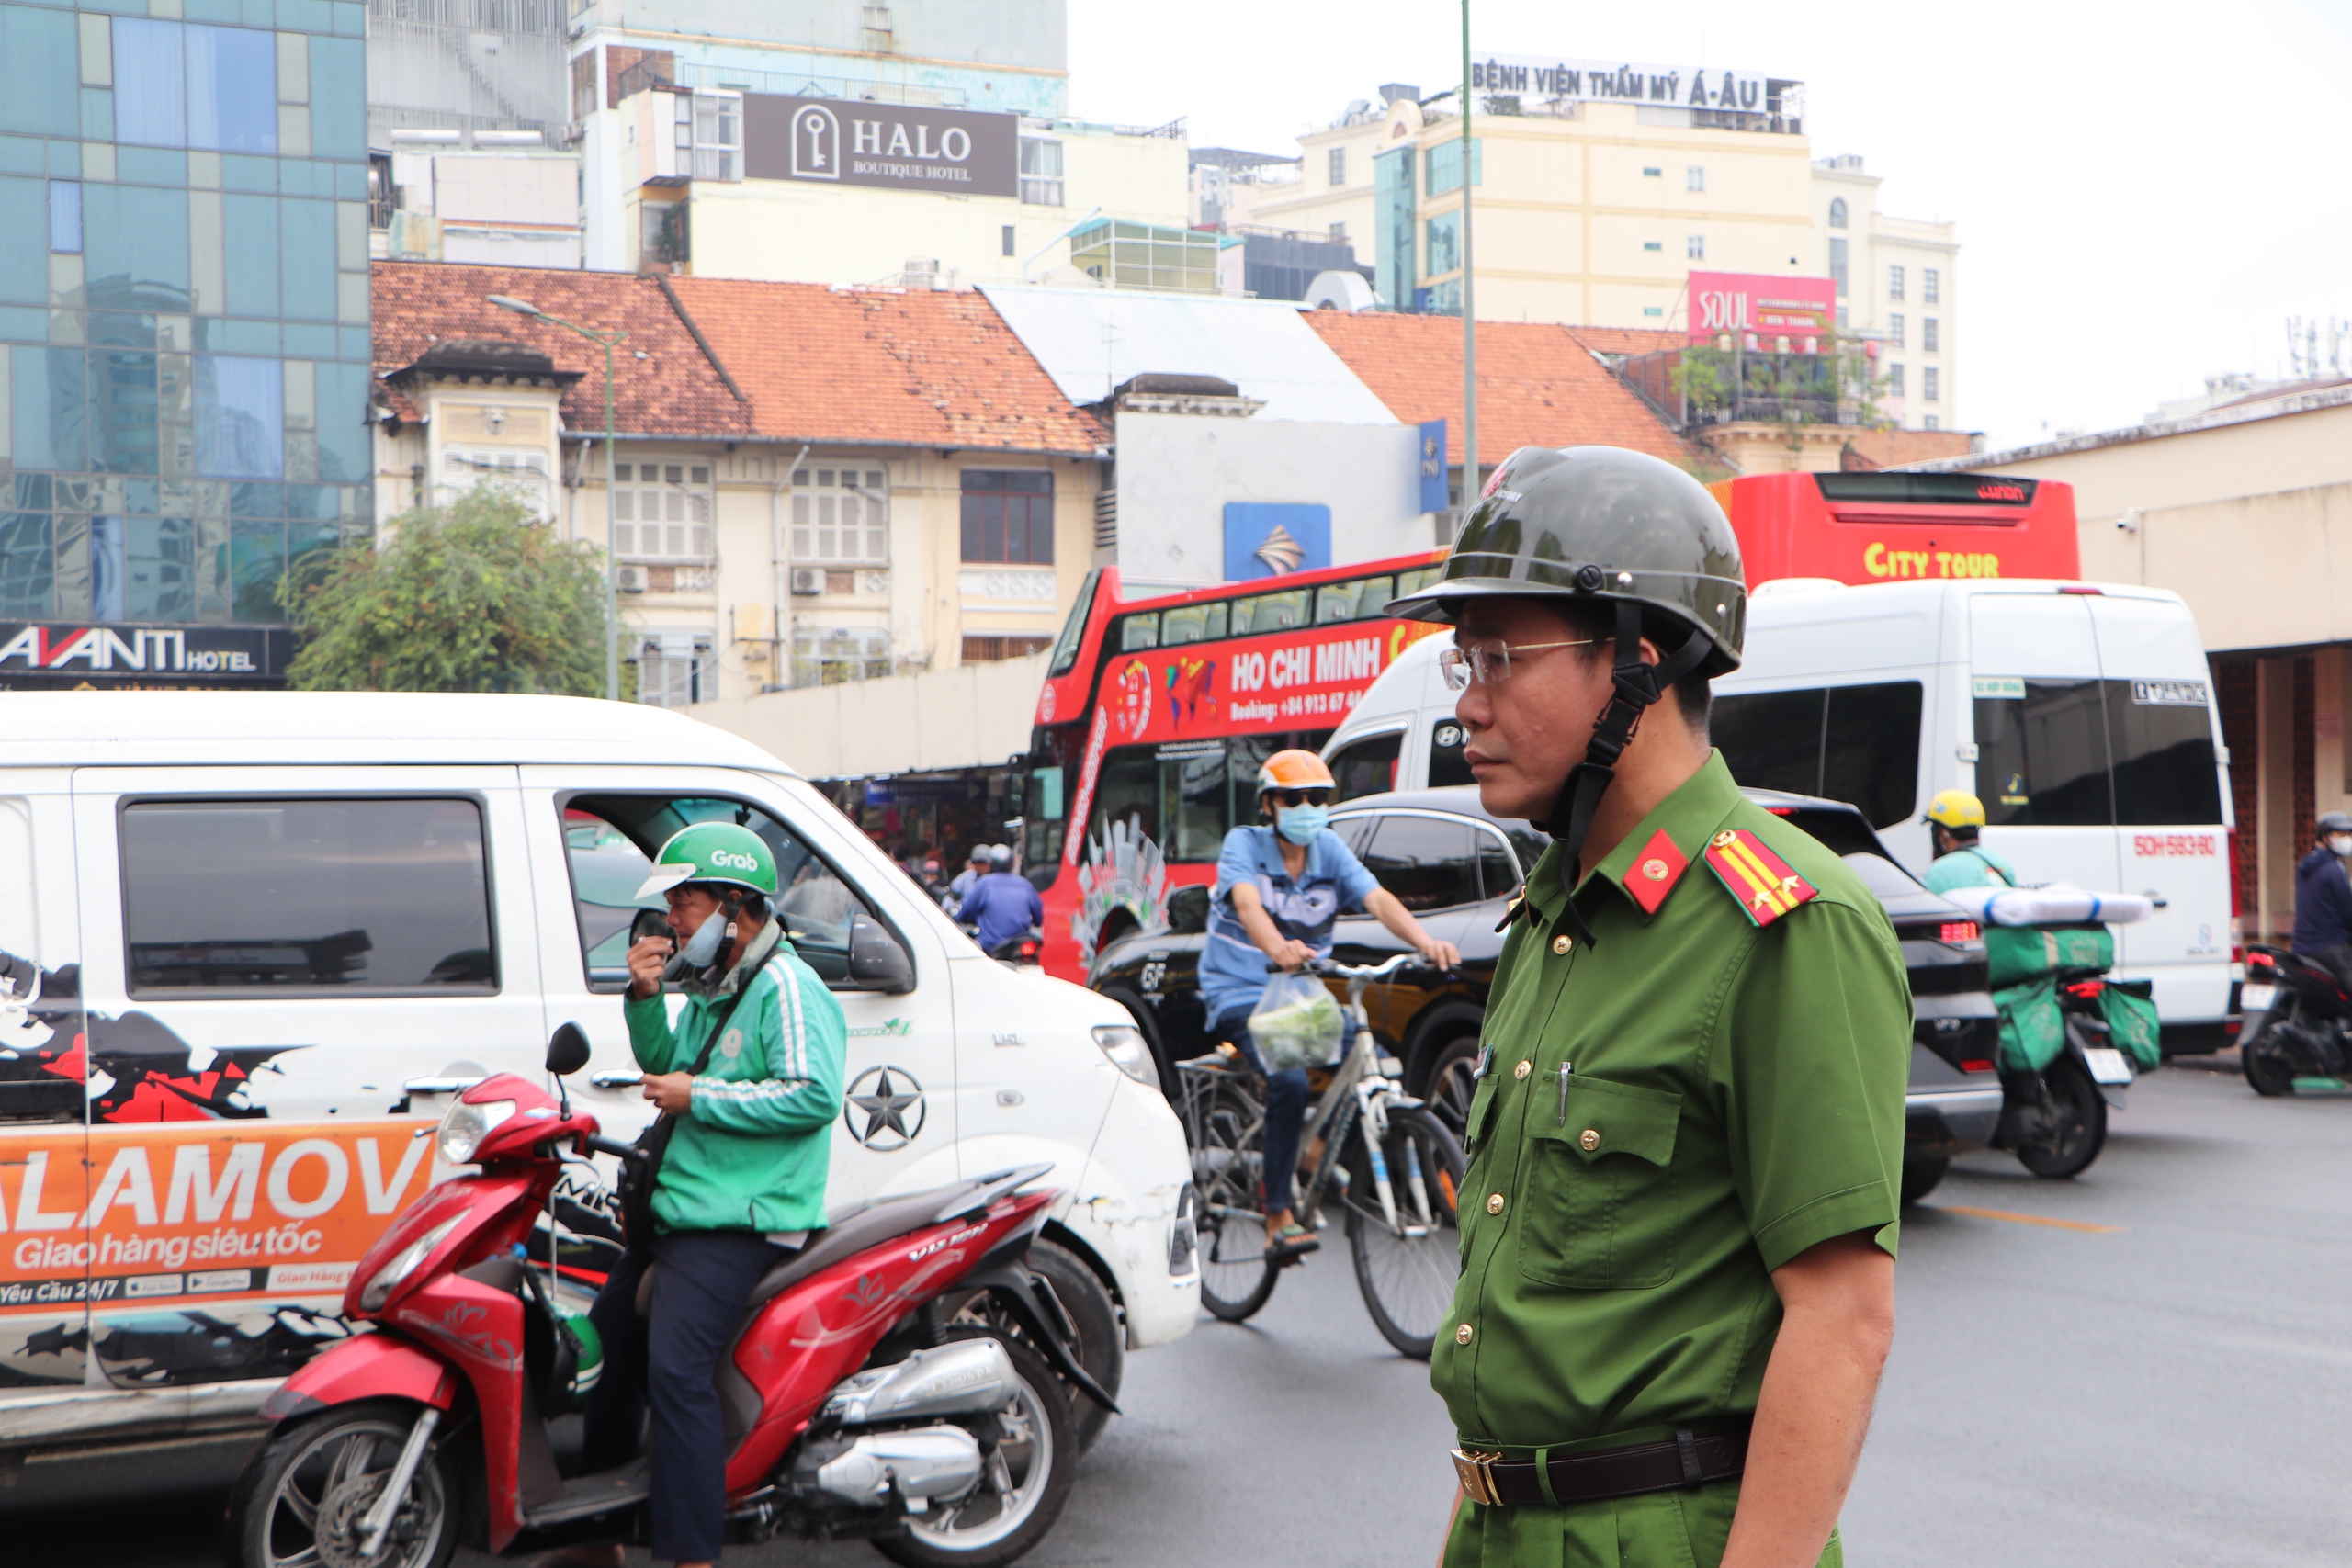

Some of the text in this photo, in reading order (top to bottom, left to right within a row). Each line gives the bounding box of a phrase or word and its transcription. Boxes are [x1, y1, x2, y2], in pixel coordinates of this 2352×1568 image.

[1472, 58, 1528, 93] BỆNH
[1534, 63, 1580, 97] VIỆN
[853, 119, 972, 162] HALO
[854, 160, 972, 182] BOUTIQUE HOTEL
[1699, 290, 1752, 331] SOUL
[1864, 542, 2000, 579] CITY TOUR
[0, 626, 257, 671] AVANTI HOTEL
[1231, 650, 1266, 692] HO
[1269, 645, 1311, 689] CHI
[1315, 637, 1382, 683] MINH
[1230, 700, 1278, 723] Booking:
[1280, 695, 1304, 716] +84
[1304, 693, 1328, 715] 913
[1329, 691, 1345, 713] 67
[711, 849, 759, 873] Grab
[0, 1135, 450, 1233] LAMOV
[14, 1219, 322, 1269] Giao hàng siêu tốc
[909, 1222, 989, 1262] VISION
[0, 1280, 119, 1304] Yêu Cầu 24/7
